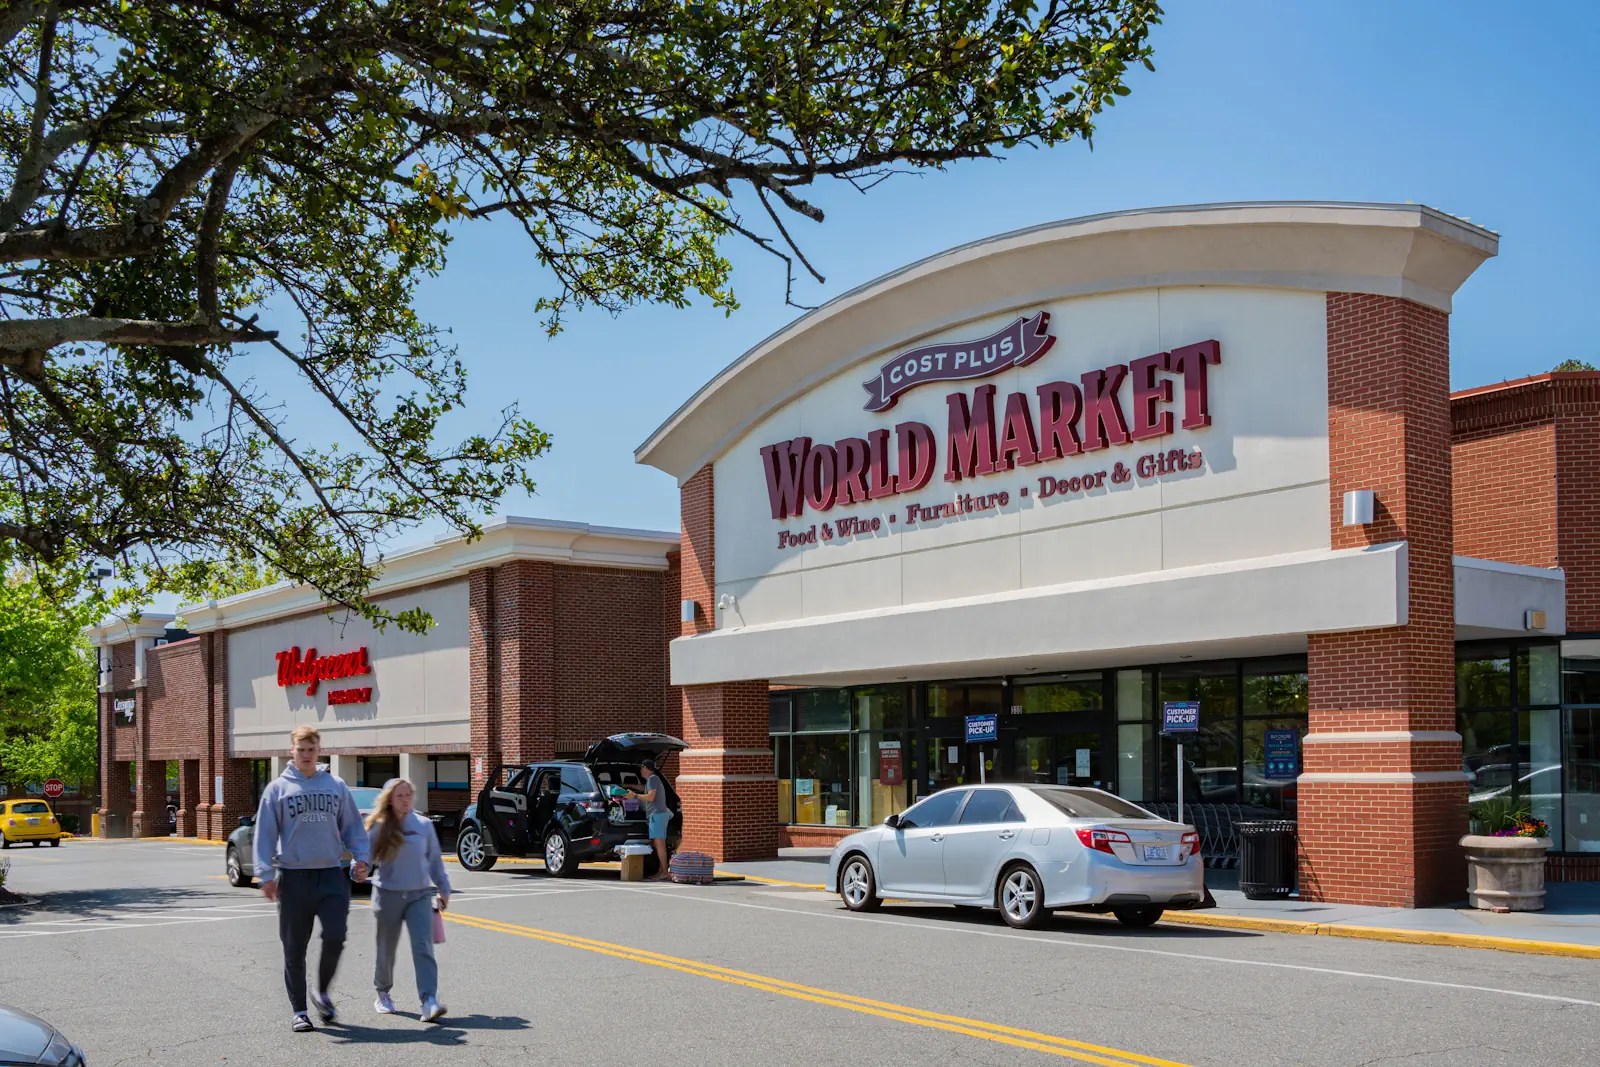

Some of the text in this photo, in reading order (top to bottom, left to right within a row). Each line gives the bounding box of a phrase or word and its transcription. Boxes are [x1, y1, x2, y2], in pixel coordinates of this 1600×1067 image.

[889, 336, 1014, 384] COST PLUS
[760, 339, 1221, 520] WORLD MARKET
[777, 448, 1203, 549] Food & Wine Furniture Decor & Gifts
[275, 646, 372, 697] Walgreens
[1166, 708, 1197, 716] CUSTOMER
[1166, 714, 1196, 724] PICK-UP
[968, 720, 995, 729] CUSTOMER
[968, 726, 995, 735] PICK-UP
[45, 784, 63, 792] STOP
